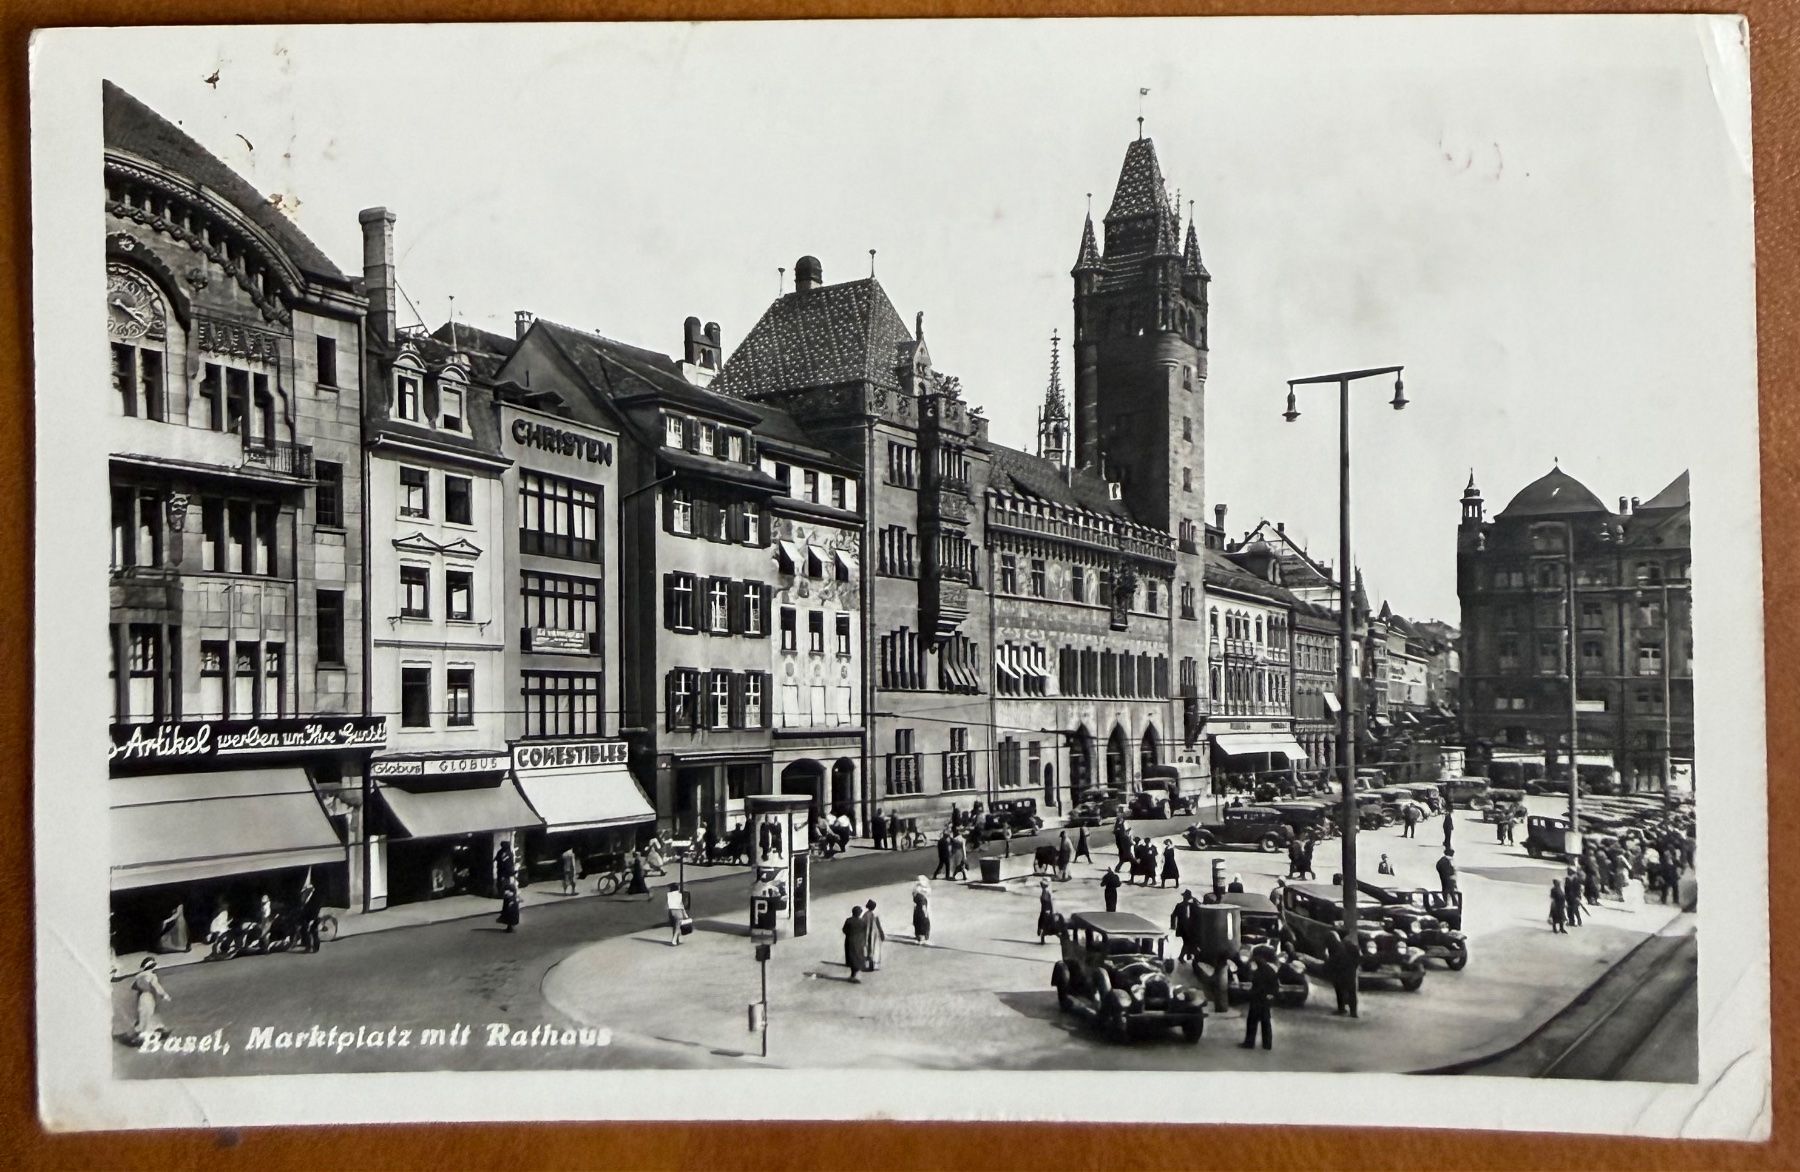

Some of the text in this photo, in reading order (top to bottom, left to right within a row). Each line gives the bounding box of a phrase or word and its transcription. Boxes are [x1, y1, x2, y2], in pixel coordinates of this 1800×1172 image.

[512, 419, 612, 467] CHRISTEN
[217, 726, 279, 748] werben
[282, 733, 305, 746] um
[305, 724, 336, 744] Ihre
[439, 757, 497, 772] GLOBUS
[517, 744, 628, 767] COMESTIBLES
[371, 762, 421, 775] Globus
[755, 900, 768, 924] P
